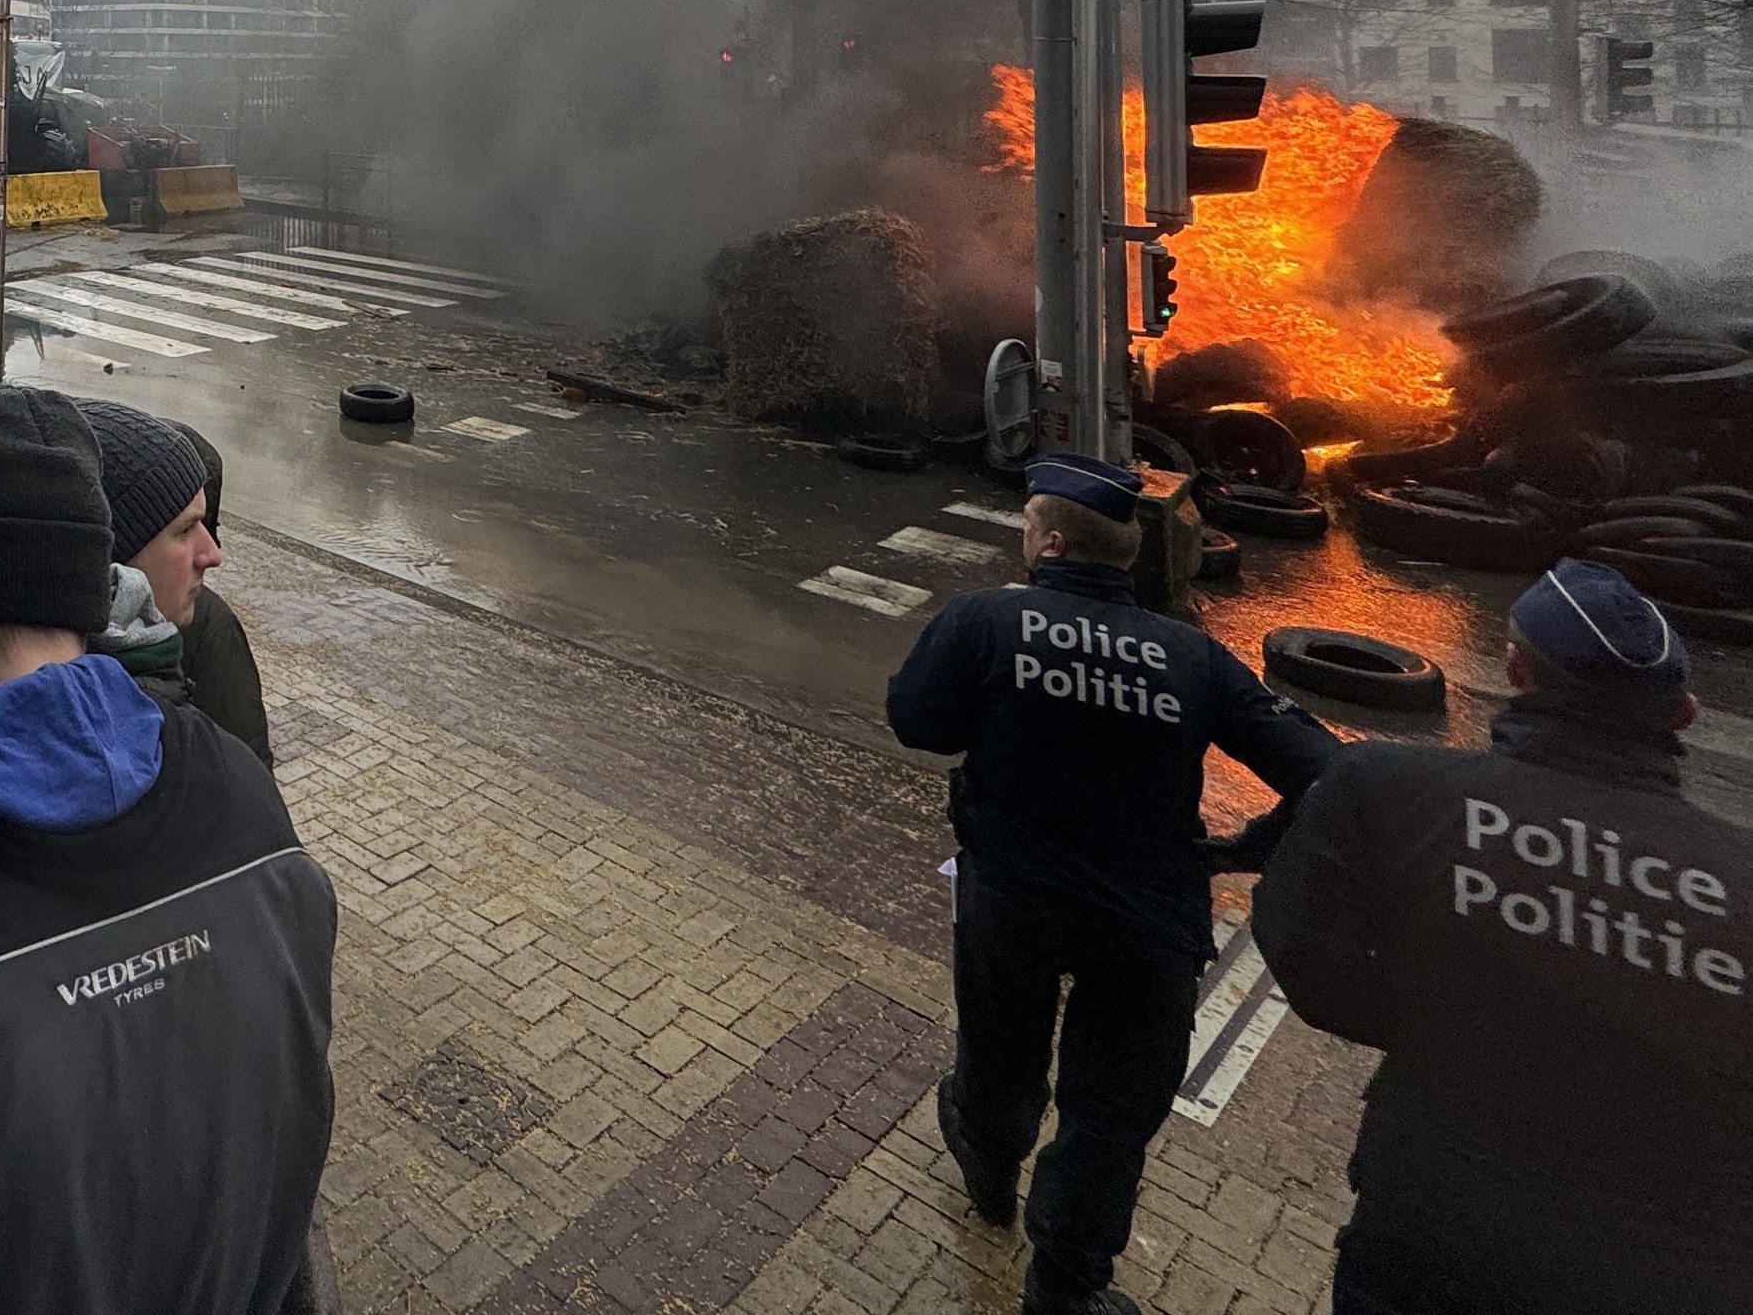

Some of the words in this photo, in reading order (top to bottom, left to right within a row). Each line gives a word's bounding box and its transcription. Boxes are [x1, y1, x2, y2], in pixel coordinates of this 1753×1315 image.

[1021, 609, 1168, 670] Police
[1014, 653, 1182, 724] Politie
[1465, 797, 1727, 917] Police
[1454, 864, 1746, 996] Politie
[56, 929, 211, 1006] VREDESTEIN
[113, 978, 166, 1008] TYRES
